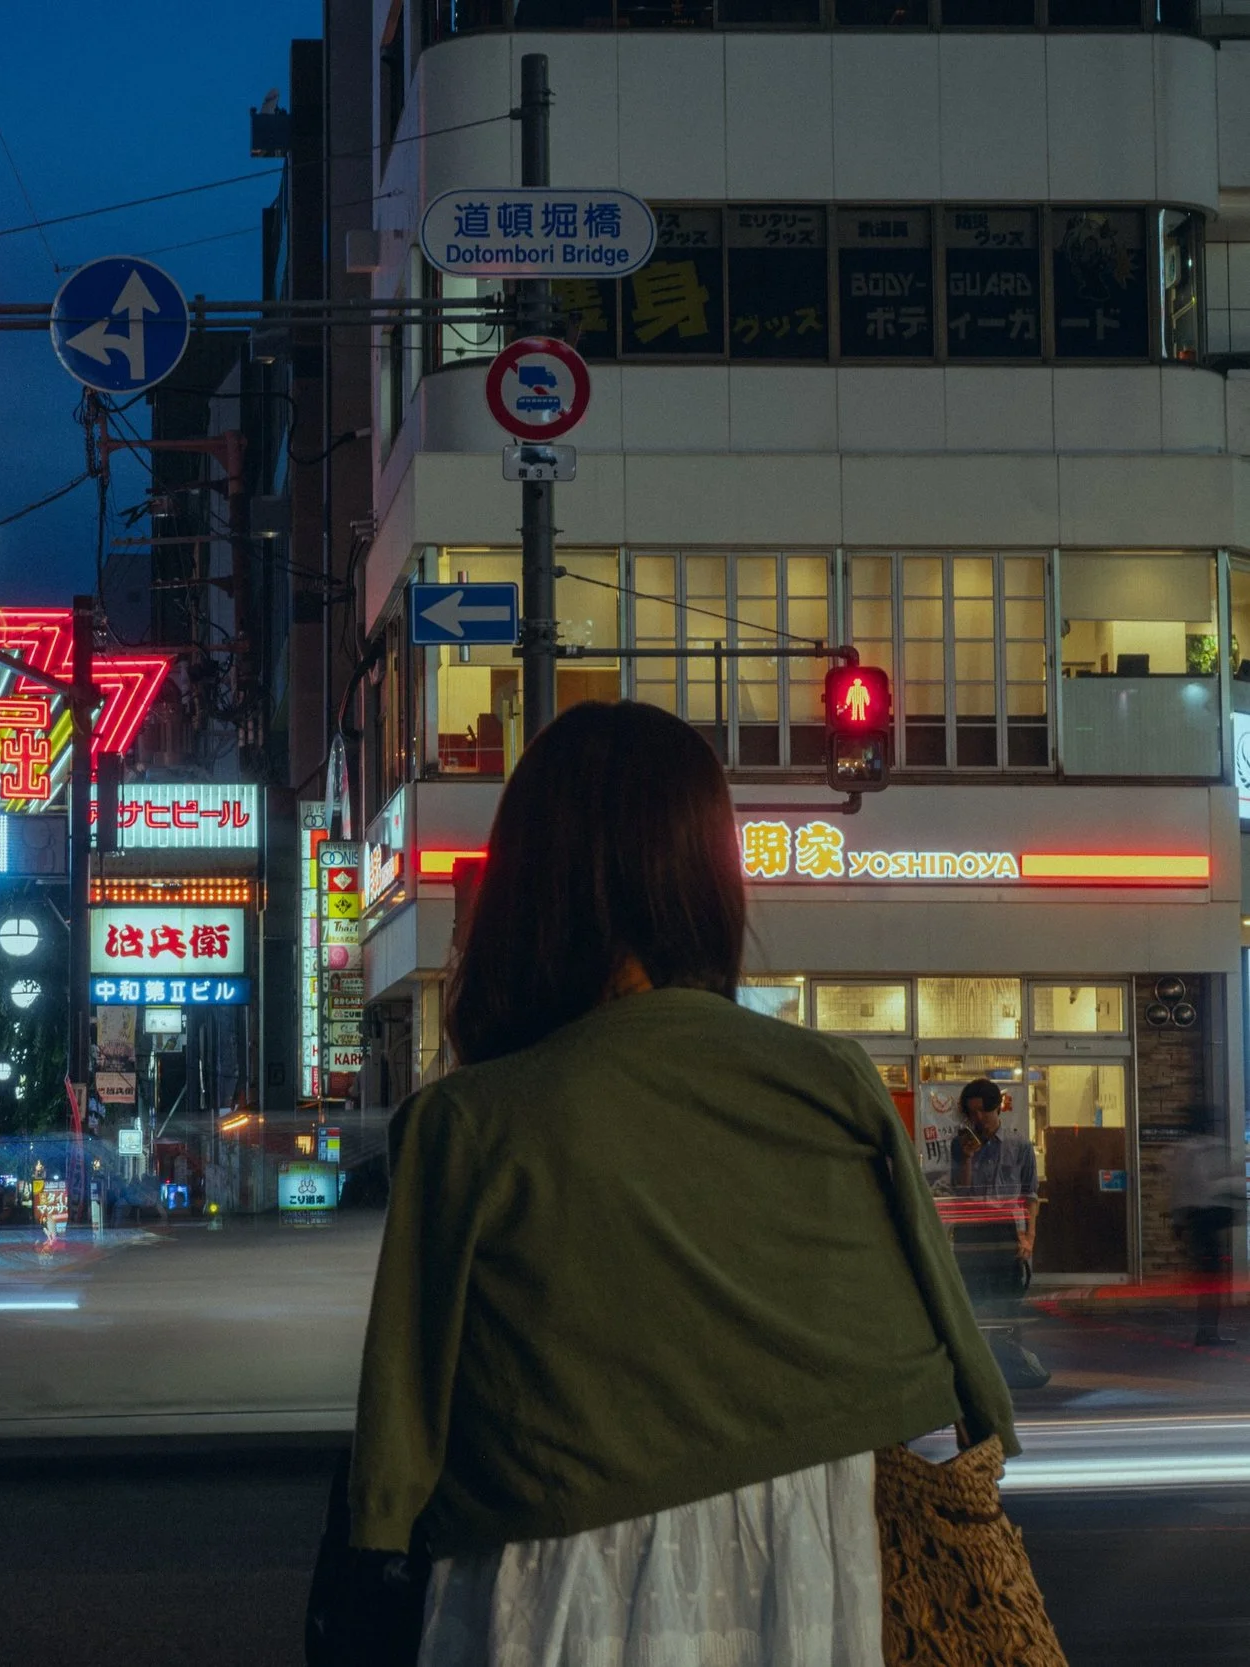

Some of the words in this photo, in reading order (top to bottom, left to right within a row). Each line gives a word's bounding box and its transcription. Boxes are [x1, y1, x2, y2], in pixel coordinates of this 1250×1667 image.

[454, 202, 622, 239] 道頓堀橋
[446, 243, 554, 264] Dotombori
[562, 243, 629, 267] Bridge
[743, 821, 845, 878] 野家
[849, 851, 1019, 879] YOSHINOYA
[37, 1203, 68, 1214] マッサ
